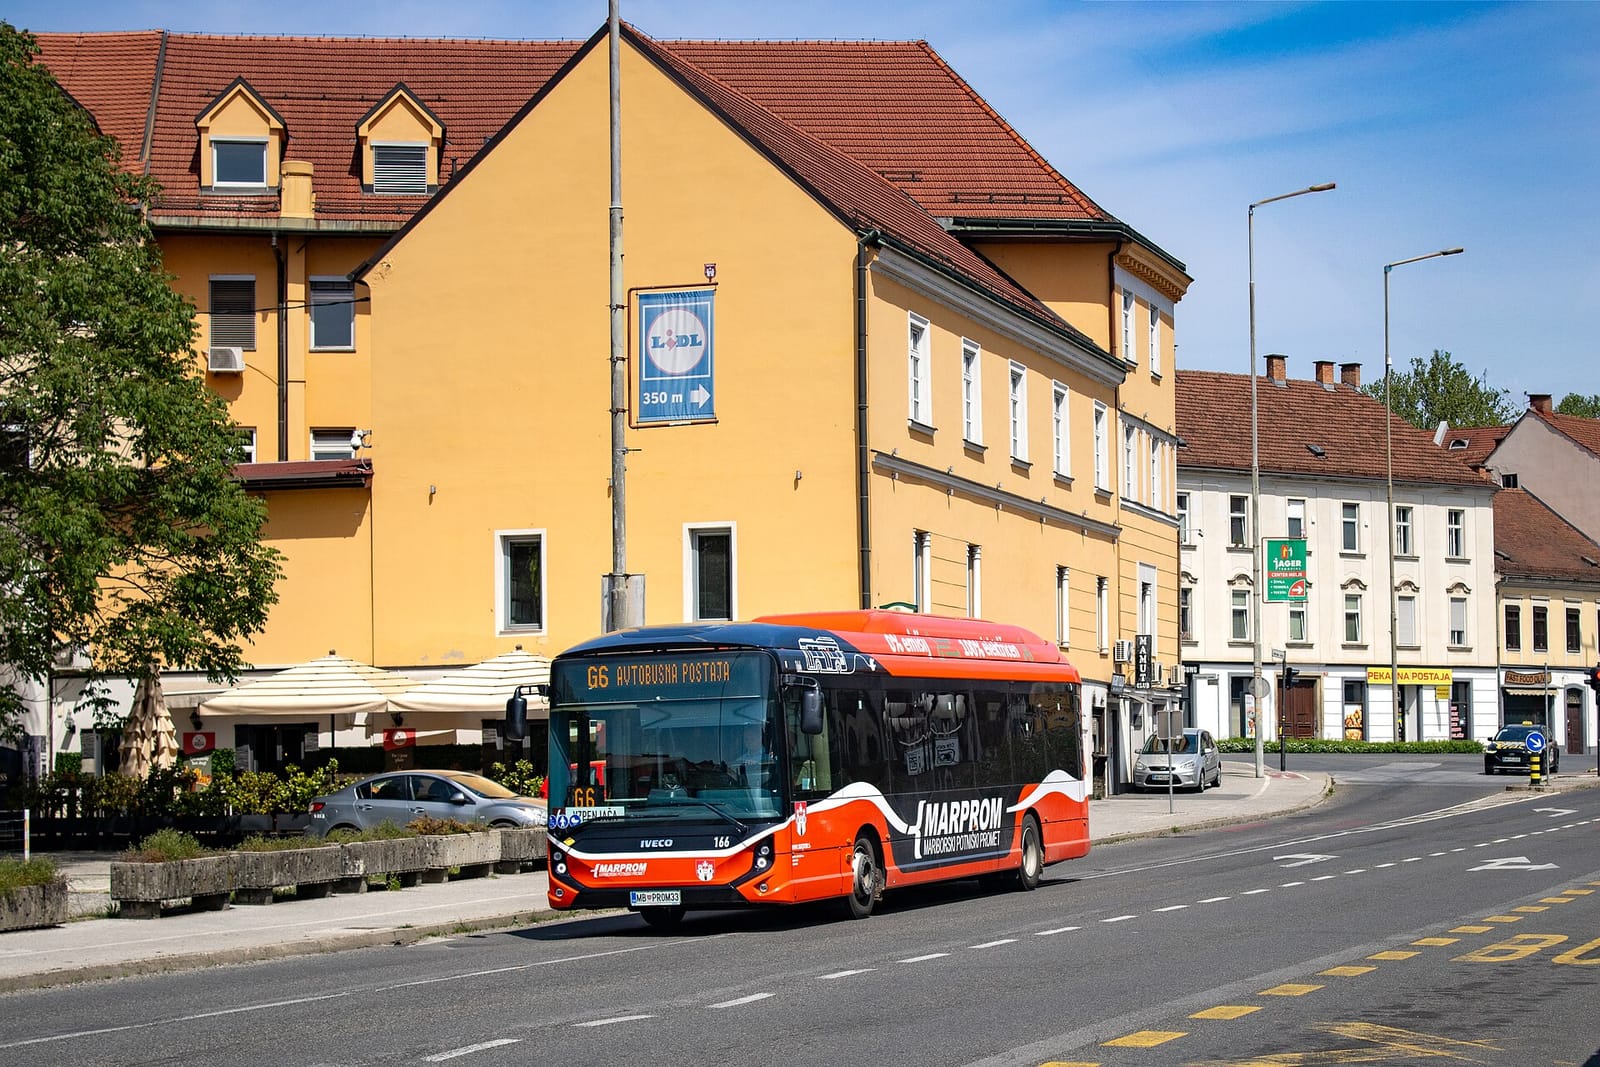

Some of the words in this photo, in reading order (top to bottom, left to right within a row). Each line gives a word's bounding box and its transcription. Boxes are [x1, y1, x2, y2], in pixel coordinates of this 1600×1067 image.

[651, 328, 703, 351] LIDL
[642, 391, 668, 405] 350
[671, 392, 684, 403] m
[1139, 636, 1147, 682] MAMUT
[587, 664, 609, 689] G6
[616, 663, 678, 686] AVTOBUSNA
[682, 661, 730, 683] POSTAJA
[1367, 671, 1410, 681] PEKANA
[1411, 672, 1451, 681] POSTAJA
[574, 787, 596, 808] G6
[924, 797, 1003, 837] MARPROM
[640, 839, 674, 848] IVECO
[713, 836, 730, 848] 166
[980, 830, 1001, 848] PROMET
[599, 862, 648, 873] MARPROM
